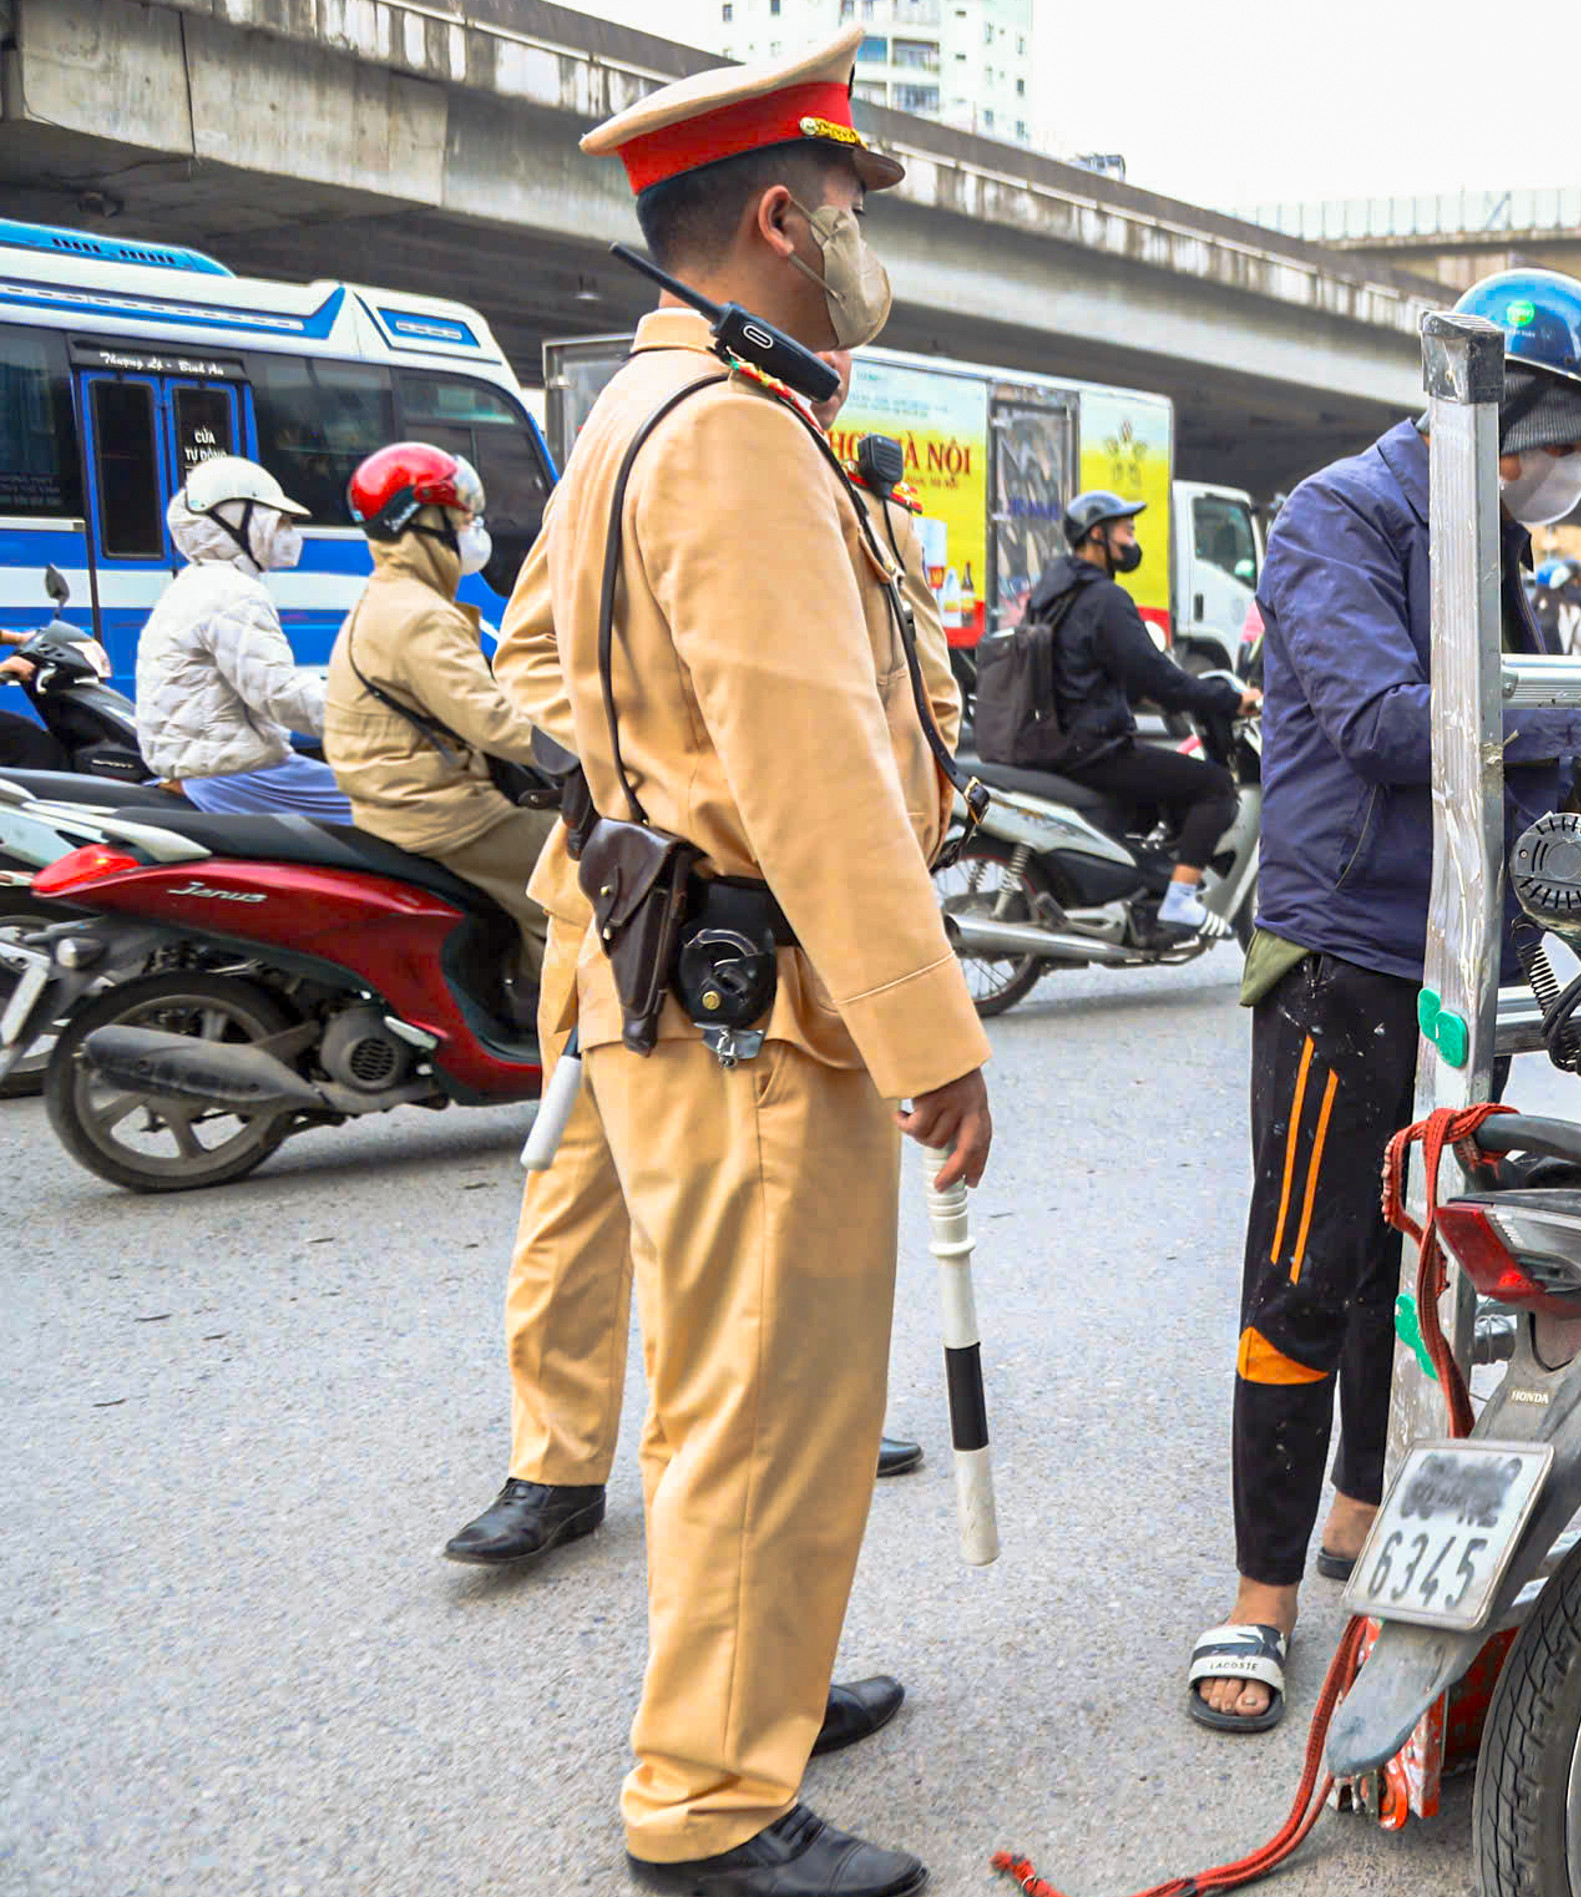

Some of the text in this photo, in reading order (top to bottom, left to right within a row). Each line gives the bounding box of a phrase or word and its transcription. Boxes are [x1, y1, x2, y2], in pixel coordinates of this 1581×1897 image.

[927, 437, 970, 475] NỘI
[166, 881, 267, 902] Janus
[1512, 1391, 1549, 1404] HONDA
[1368, 1530, 1488, 1608] 6345
[1210, 1661, 1258, 1671] LACOSTE
